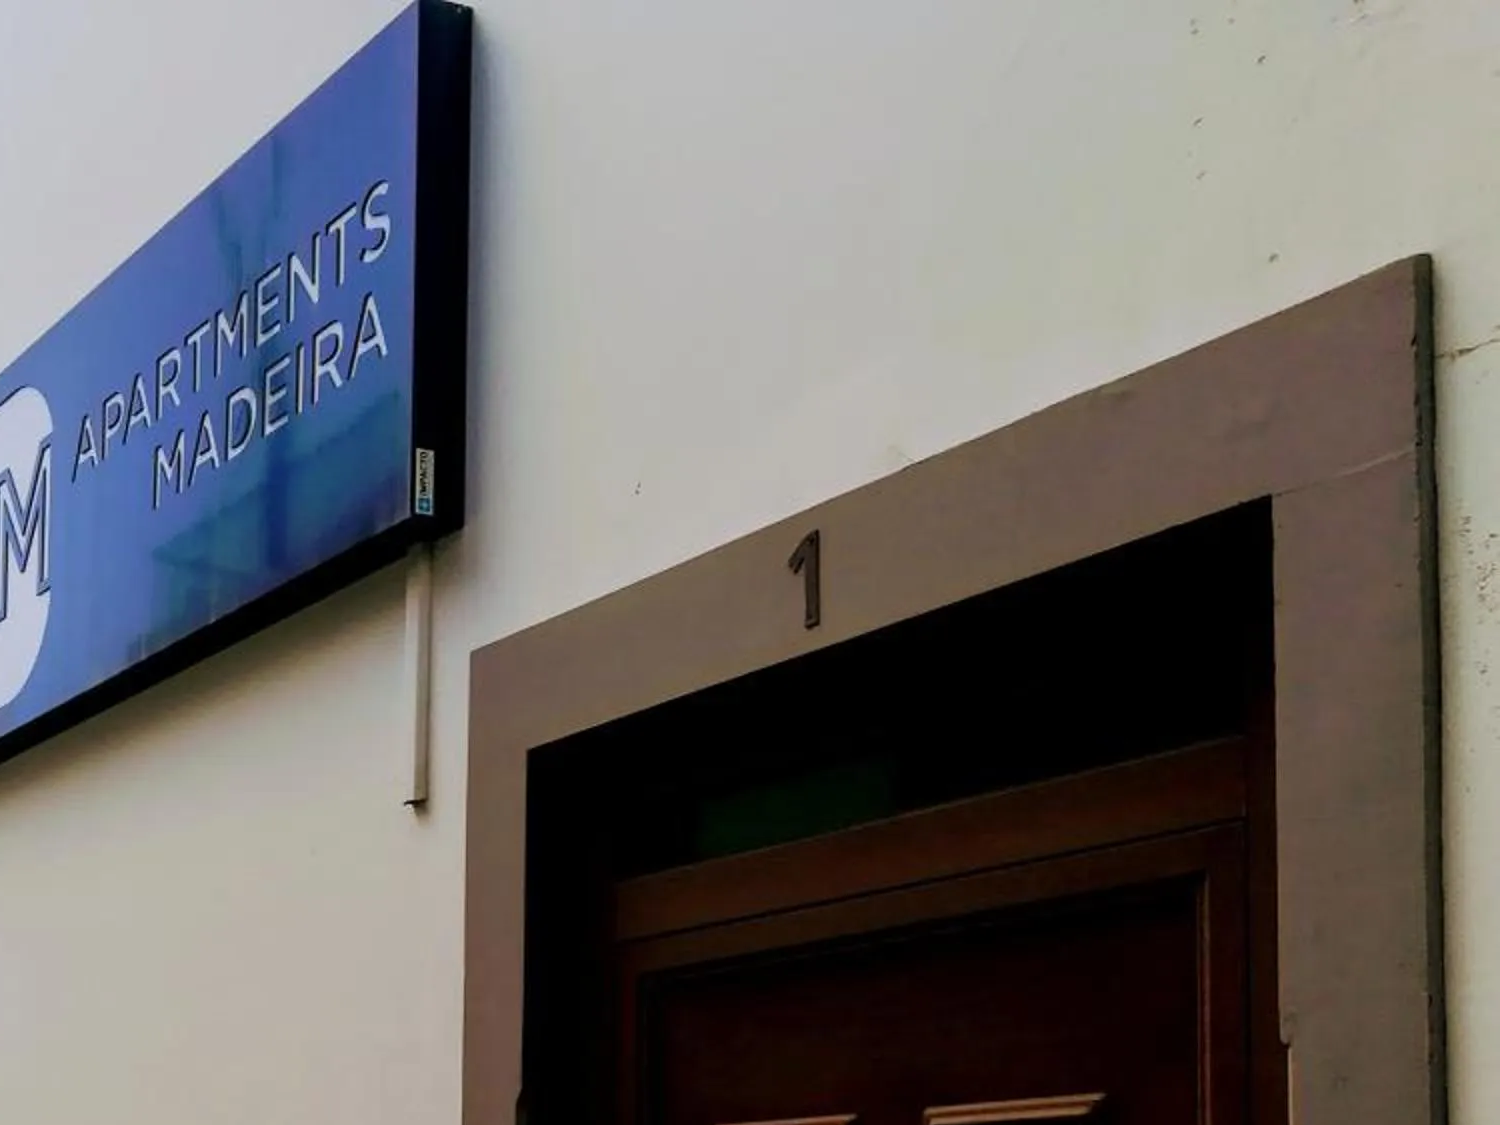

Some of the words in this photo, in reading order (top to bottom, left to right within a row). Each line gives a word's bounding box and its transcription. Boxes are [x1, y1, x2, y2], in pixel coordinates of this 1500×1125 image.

[72, 179, 389, 483] APARTMENTS
[152, 293, 388, 510] MADEIRA
[788, 529, 820, 630] 1
